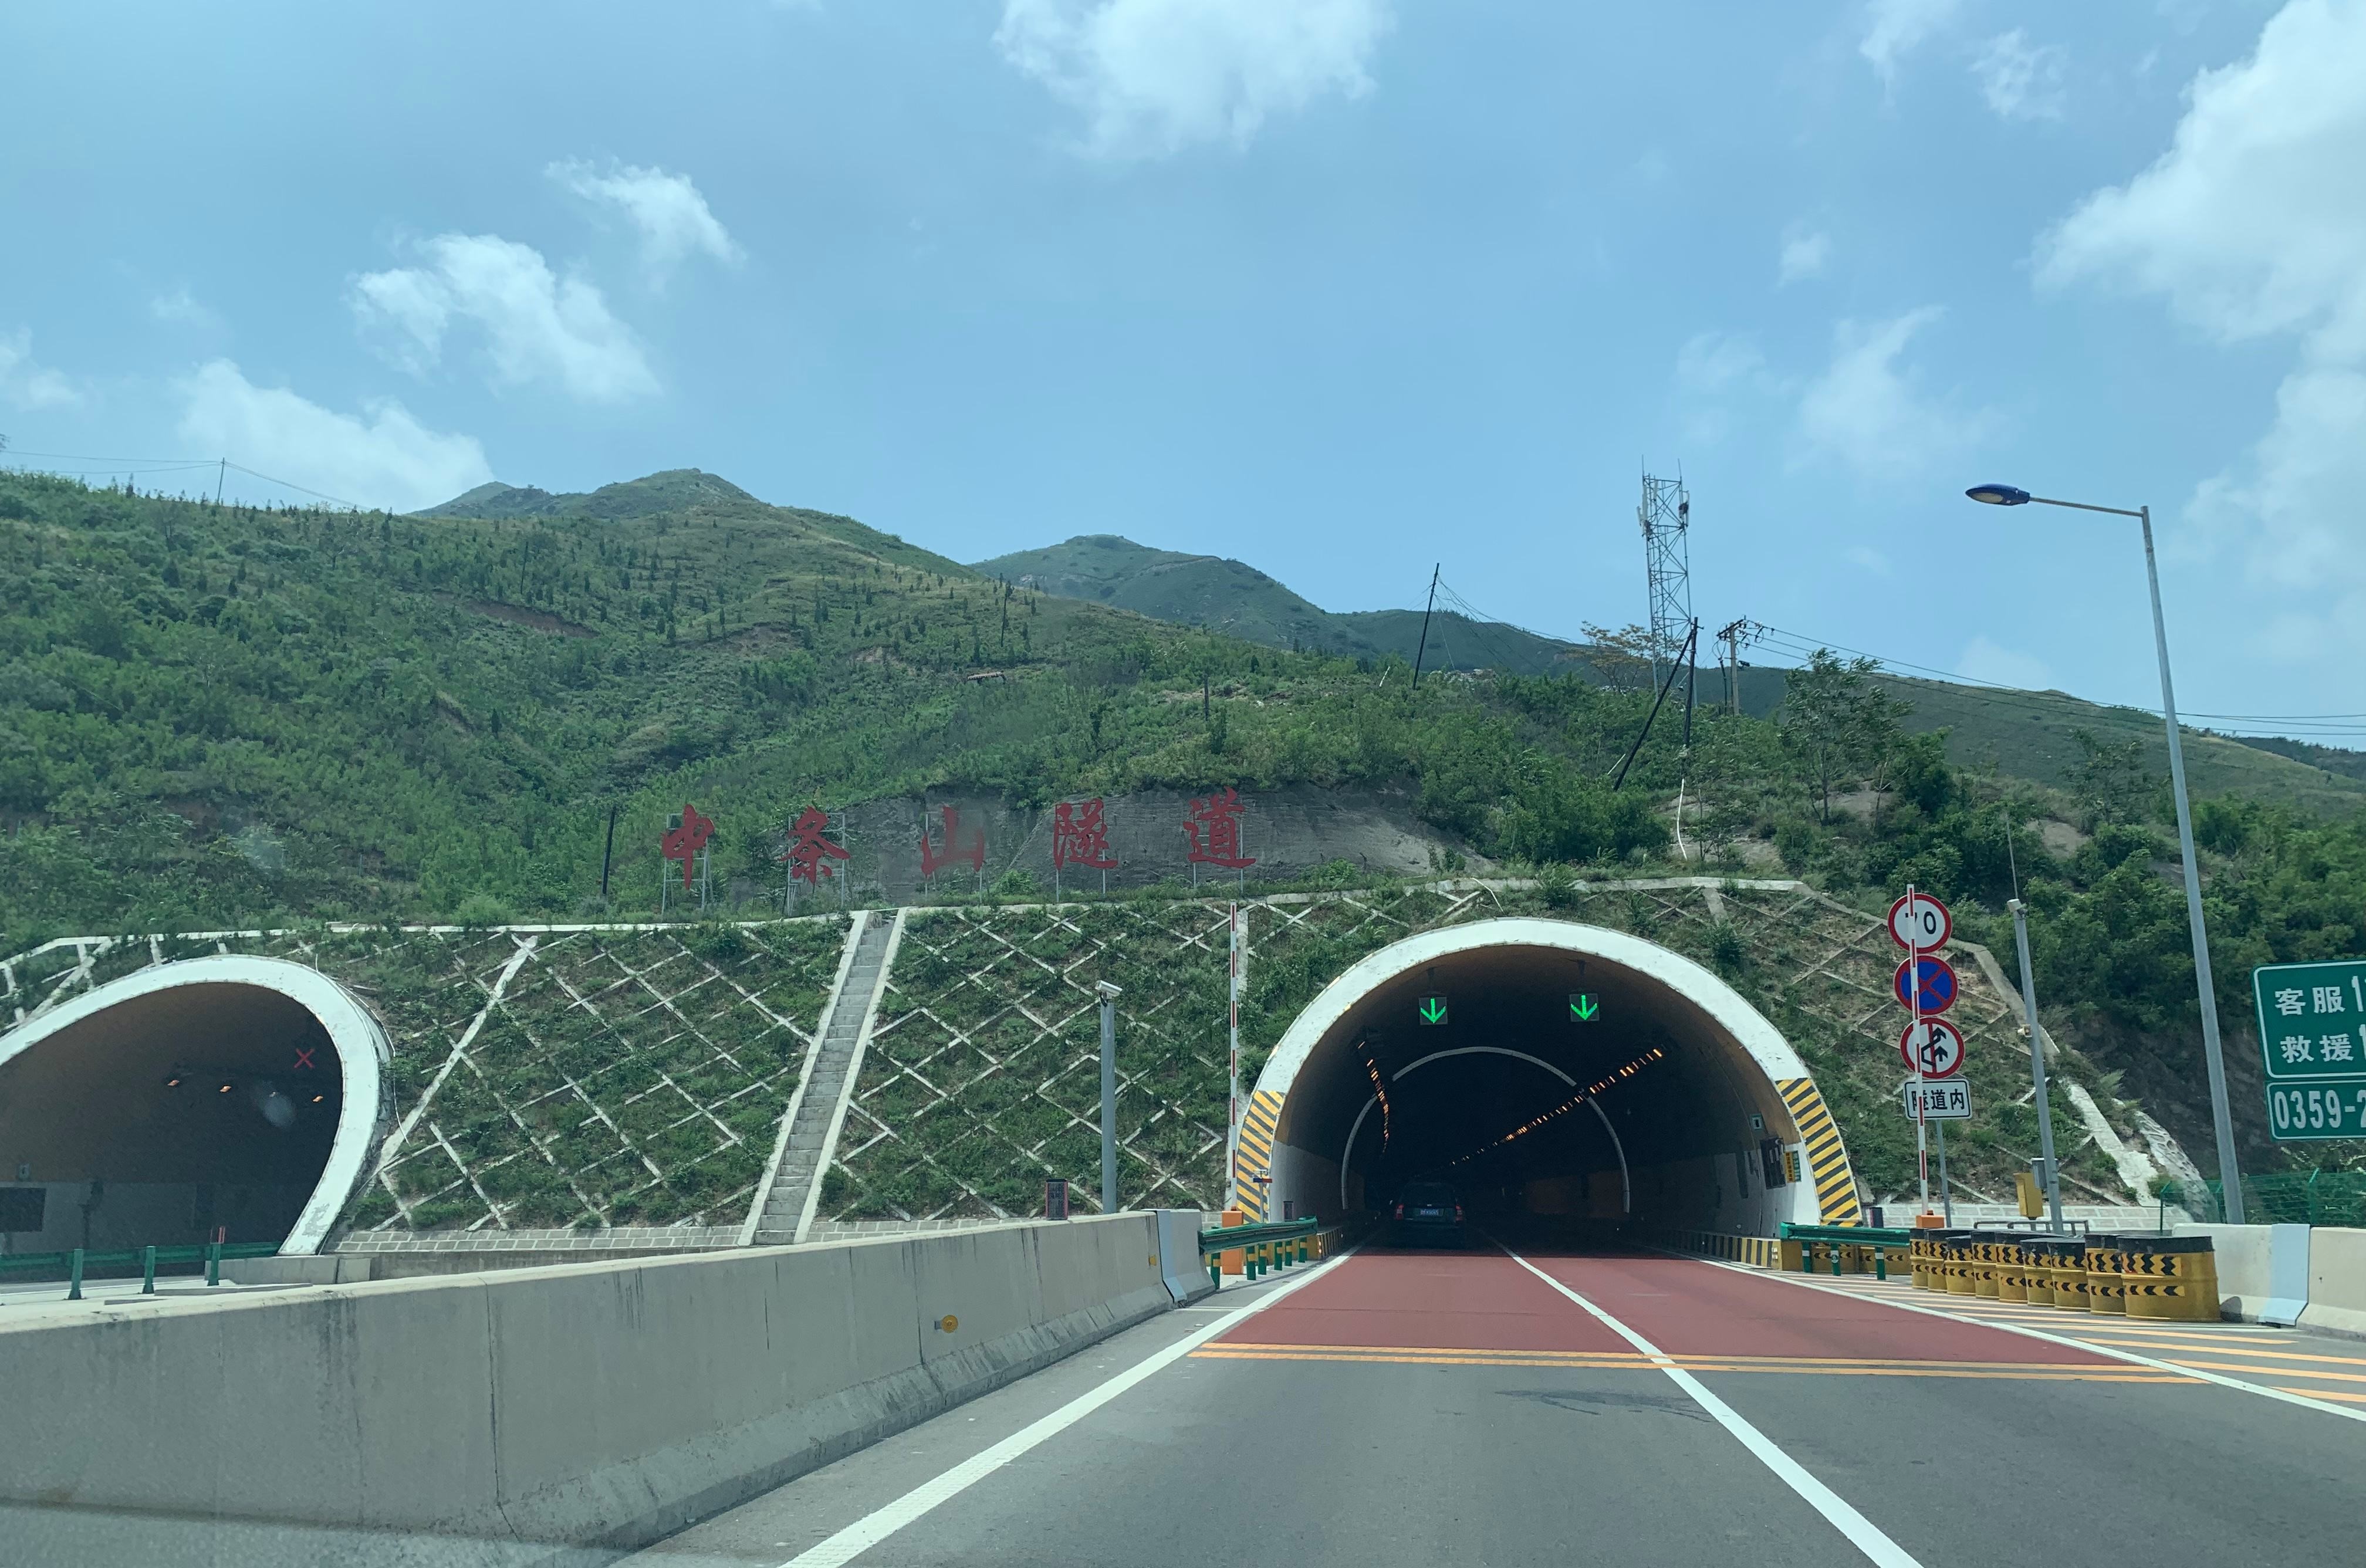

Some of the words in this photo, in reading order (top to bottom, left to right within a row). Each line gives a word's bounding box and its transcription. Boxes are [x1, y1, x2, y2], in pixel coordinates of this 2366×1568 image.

[661, 785, 1256, 890] 中条山隧道
[2274, 986, 2345, 1016] 客服
[2280, 1033, 2354, 1063] 救援
[2274, 1089, 2366, 1129] 0359-2
